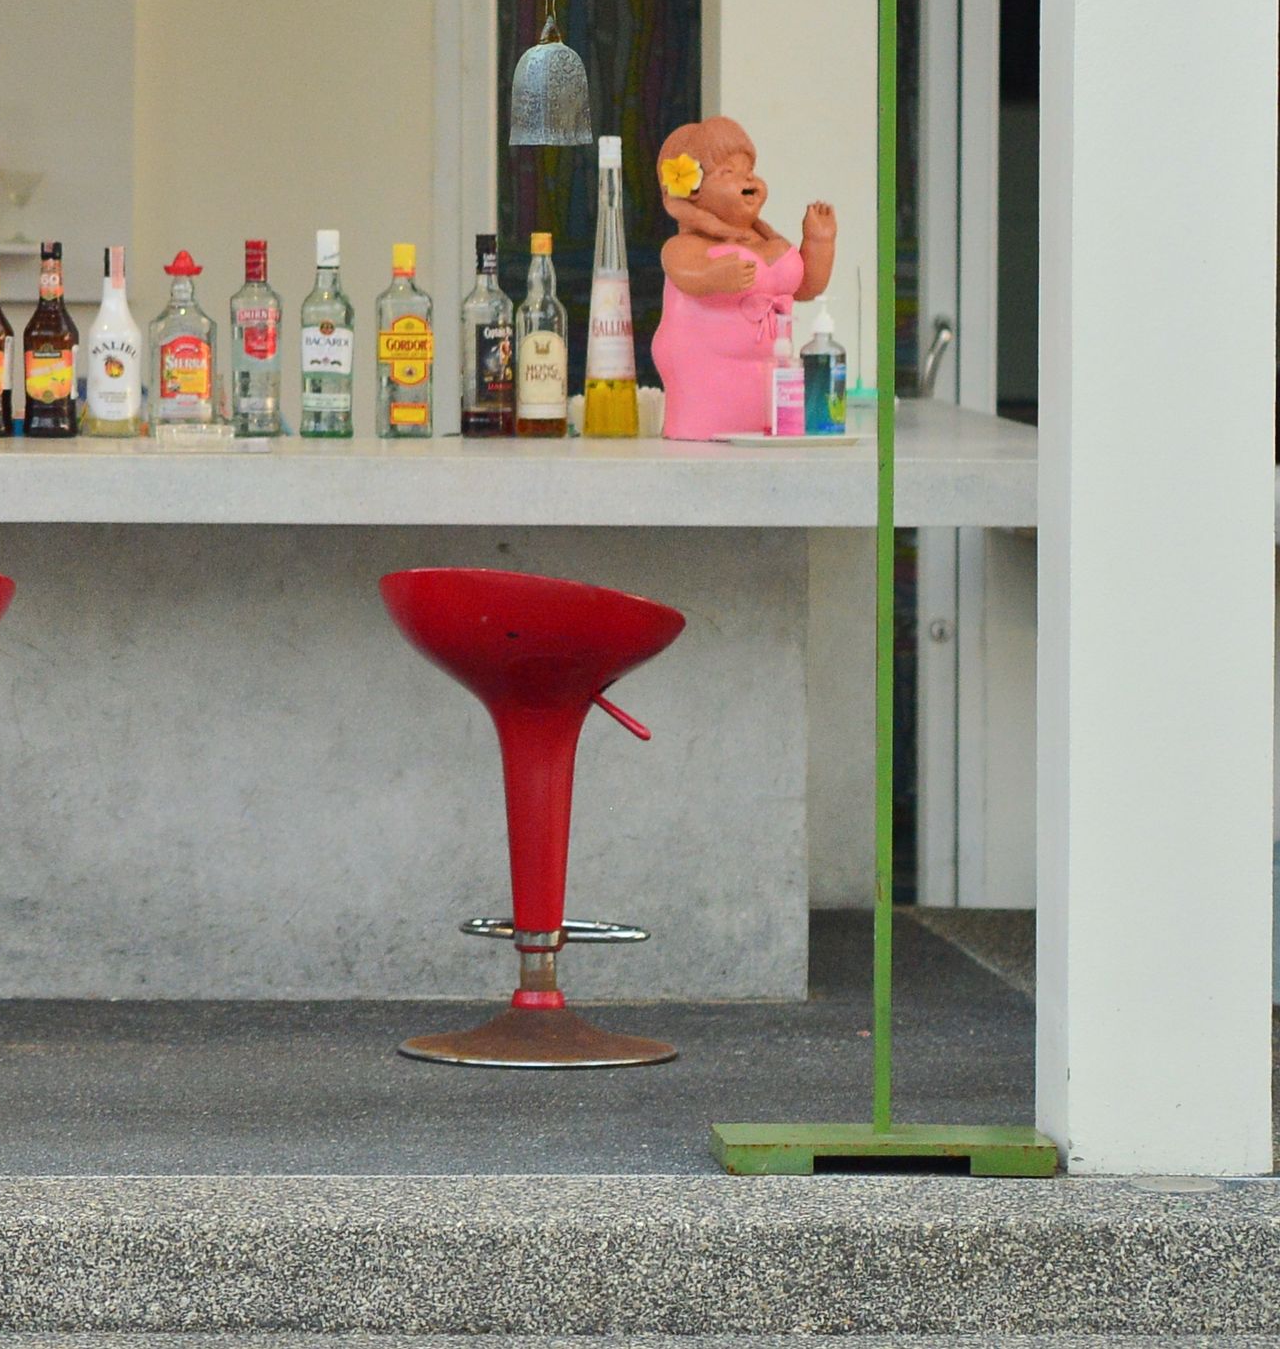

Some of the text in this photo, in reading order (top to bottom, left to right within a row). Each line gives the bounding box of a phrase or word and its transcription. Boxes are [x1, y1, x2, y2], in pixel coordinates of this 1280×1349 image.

[305, 336, 349, 346] BACARDI
[92, 341, 137, 357] MALIBU
[167, 355, 206, 369] SIERRA
